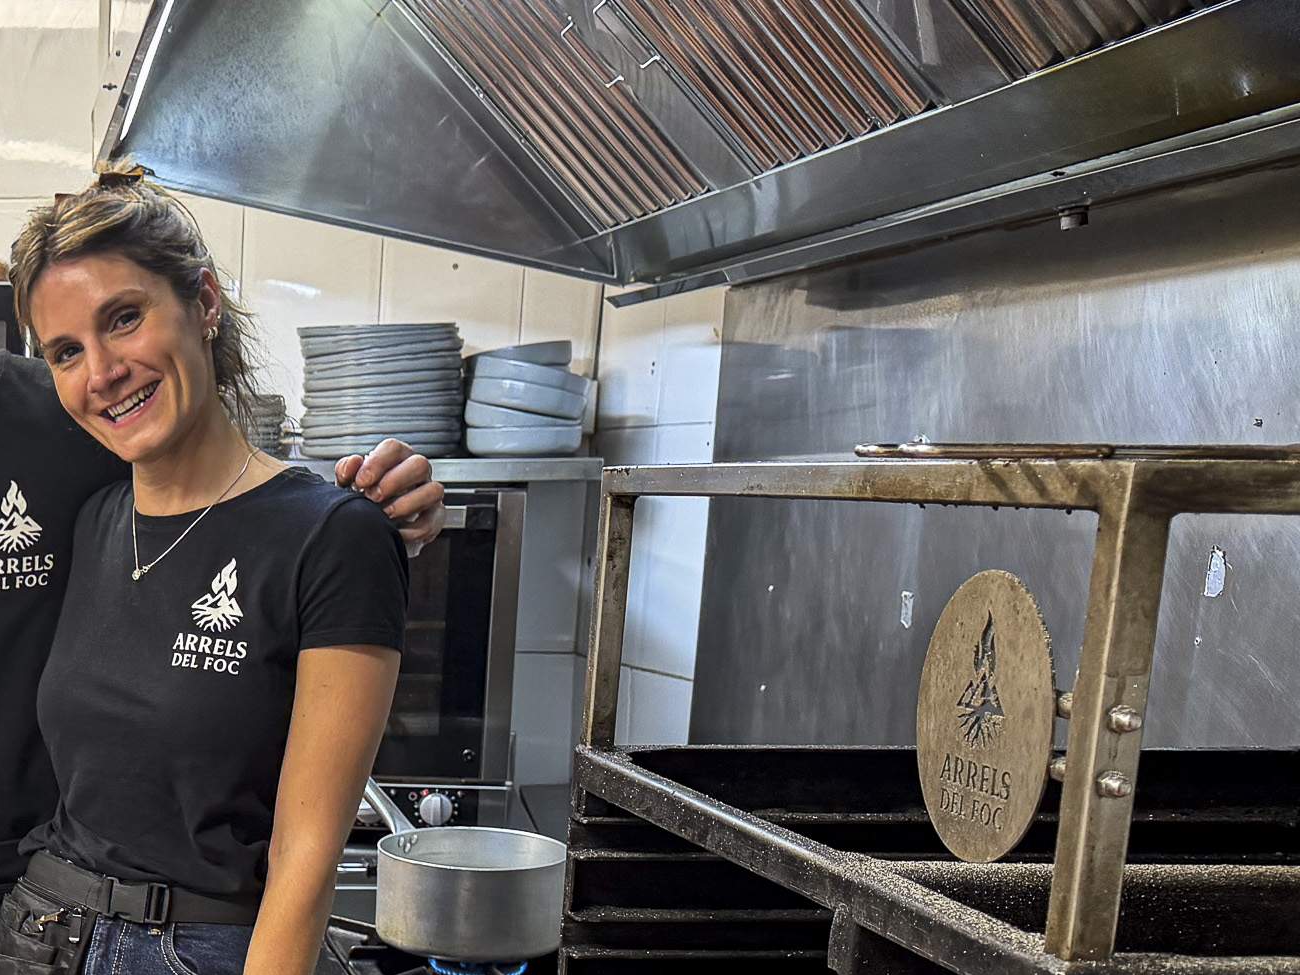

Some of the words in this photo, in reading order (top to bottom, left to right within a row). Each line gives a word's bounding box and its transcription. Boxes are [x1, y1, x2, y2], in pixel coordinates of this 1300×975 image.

[15, 573, 48, 589] FOC
[172, 632, 248, 659] ARRELS
[171, 652, 198, 669] DEL
[203, 656, 240, 675] FOC
[940, 753, 1012, 800] ARRELS
[939, 787, 967, 816] DEL
[971, 799, 1004, 830] FOC
